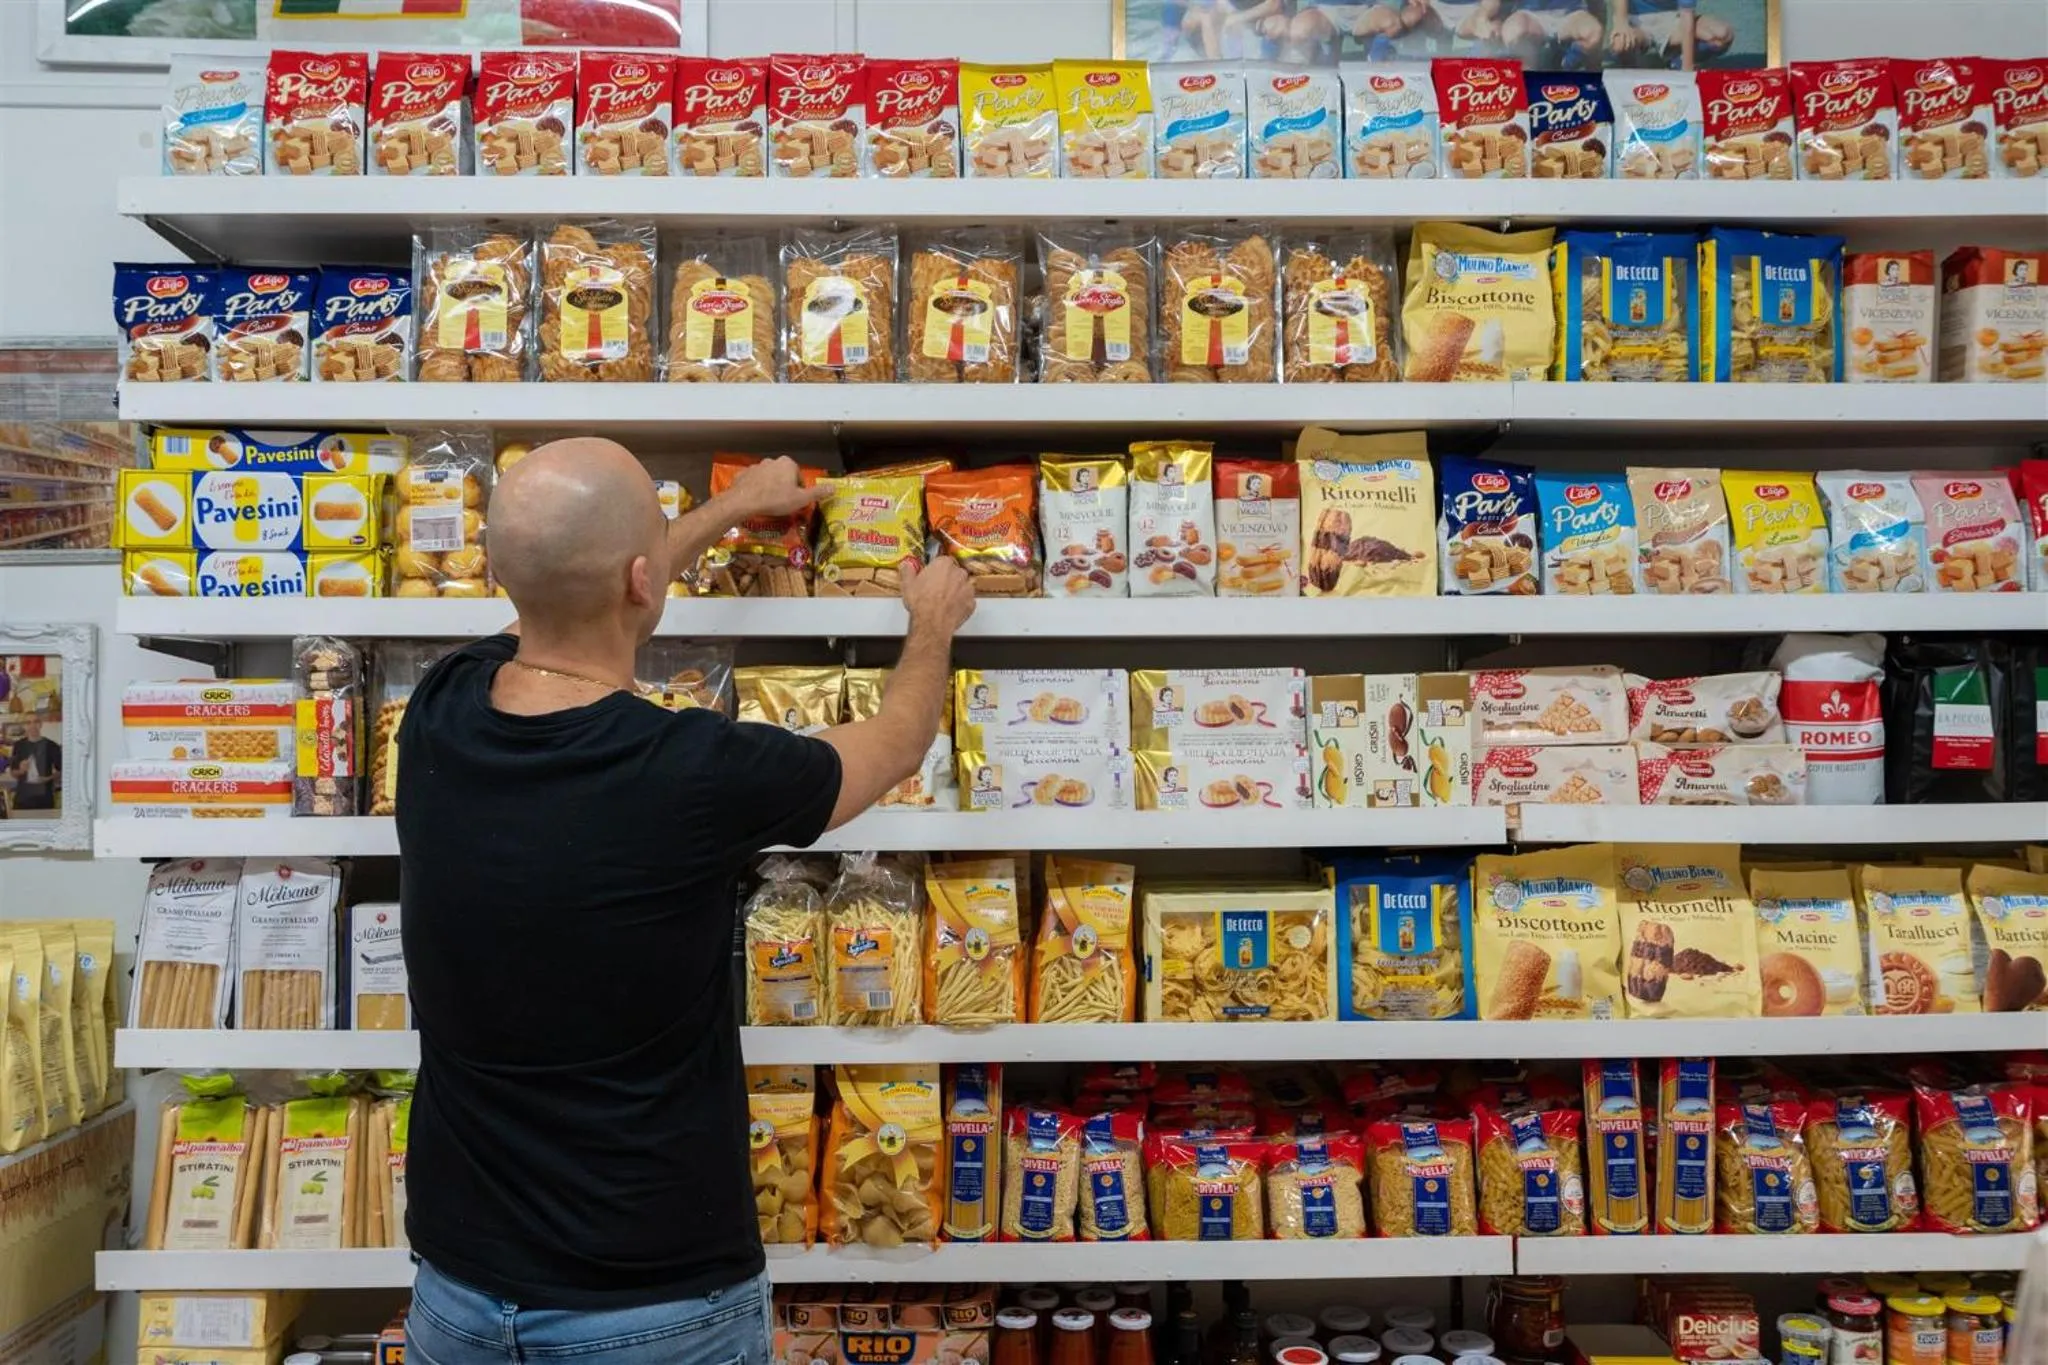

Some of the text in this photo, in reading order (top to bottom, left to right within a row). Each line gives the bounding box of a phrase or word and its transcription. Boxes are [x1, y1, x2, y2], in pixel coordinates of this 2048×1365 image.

[410, 65, 441, 79] Lago
[613, 66, 646, 80] Lago
[708, 70, 740, 84] Lago
[900, 70, 930, 84] Lago
[1089, 73, 1117, 84] Lago
[1466, 69, 1496, 81] Lago
[2007, 70, 2036, 83] Lago
[994, 75, 1024, 86] Lago
[1181, 76, 1213, 89] Lago
[1275, 75, 1307, 88] Lago
[1372, 78, 1402, 90] Lago
[278, 75, 353, 104] Party
[382, 80, 455, 107] Party
[487, 78, 556, 107] Party
[589, 81, 664, 108] Party
[778, 83, 851, 110] Party
[1448, 82, 1517, 110] Party
[1545, 87, 1576, 98] Lago
[1636, 86, 1668, 98] Lago
[1726, 84, 1759, 98] Lago
[685, 84, 755, 111] Party
[877, 83, 948, 112] Party
[974, 88, 1044, 113] Party
[1069, 86, 1137, 112] Party
[1803, 87, 1878, 115] Party
[1903, 84, 1973, 112] Party
[1530, 100, 1598, 128] Party
[1707, 95, 1780, 123] Party
[1458, 254, 1494, 274] MULINO
[1616, 264, 1659, 281] DE CECCO
[1765, 264, 1806, 282] DE CECCO
[153, 278, 184, 292] Lago
[254, 275, 285, 289] Lago
[353, 279, 386, 292] Lago
[1426, 286, 1536, 306] Biscottone
[124, 293, 203, 321] Party
[226, 291, 301, 320] Party
[326, 294, 403, 321] Party
[147, 322, 181, 334] Cacao
[345, 323, 377, 335] Cacao
[245, 446, 316, 465] Pavesini
[1377, 459, 1412, 472] BIANCO
[1477, 476, 1506, 490] Lago
[1321, 486, 1417, 504] Ritornelli
[1569, 487, 1598, 501] Lago
[1757, 486, 1787, 499] Lago
[1948, 484, 1979, 498] Lago
[196, 496, 298, 525] Pavesini
[1455, 492, 1524, 520] Party
[1552, 502, 1621, 533] Party
[1743, 501, 1810, 531] Party
[1933, 502, 2001, 527] Party
[1221, 523, 1288, 535] VICENZOVO
[200, 573, 302, 597] Pavesini
[203, 691, 232, 700] CRICH
[1491, 687, 1524, 696] Bonomi
[185, 705, 250, 716] CRACKERS
[1481, 701, 1540, 714] Sfogliatine
[1655, 704, 1708, 719] Amaretti
[1801, 731, 1872, 745] ROMEO
[191, 767, 220, 776] CRICH
[1502, 765, 1535, 774] Bonomi
[172, 781, 237, 793] CRACKERS
[1488, 779, 1550, 792] Sfogliatine
[1674, 777, 1727, 790] Amaretti
[1652, 866, 1688, 881] MULINO
[1521, 877, 1592, 896] MULINO BIANCO
[247, 885, 320, 906] Molisana
[1384, 894, 1427, 909] DE CECCO
[157, 906, 222, 918] GRANO ITALIANO
[1637, 896, 1735, 915] Ritornelli
[251, 915, 318, 925] GRANO ITALIANO
[1227, 918, 1264, 931] DE CECCO
[1498, 914, 1606, 932] Biscottone
[354, 926, 401, 942] Molisan
[1776, 929, 1838, 945] Macine
[1883, 922, 1960, 940] Tarallucci
[951, 1123, 988, 1134] DIVELLA
[1600, 1120, 1639, 1132] DIVELLA
[1673, 1121, 1710, 1132] DIVELLA
[1969, 1150, 2010, 1162] DIVELLA
[178, 1162, 234, 1173] STIRATINI
[288, 1158, 342, 1170] STIRATINI
[1024, 1159, 1059, 1170] DIVELLA
[1088, 1159, 1122, 1171] DIVELLA
[1200, 1183, 1234, 1194] DIVELLA
[951, 1308, 976, 1318] RIO
[1679, 1315, 1759, 1335] Delicius
[847, 1336, 912, 1354] RIO
